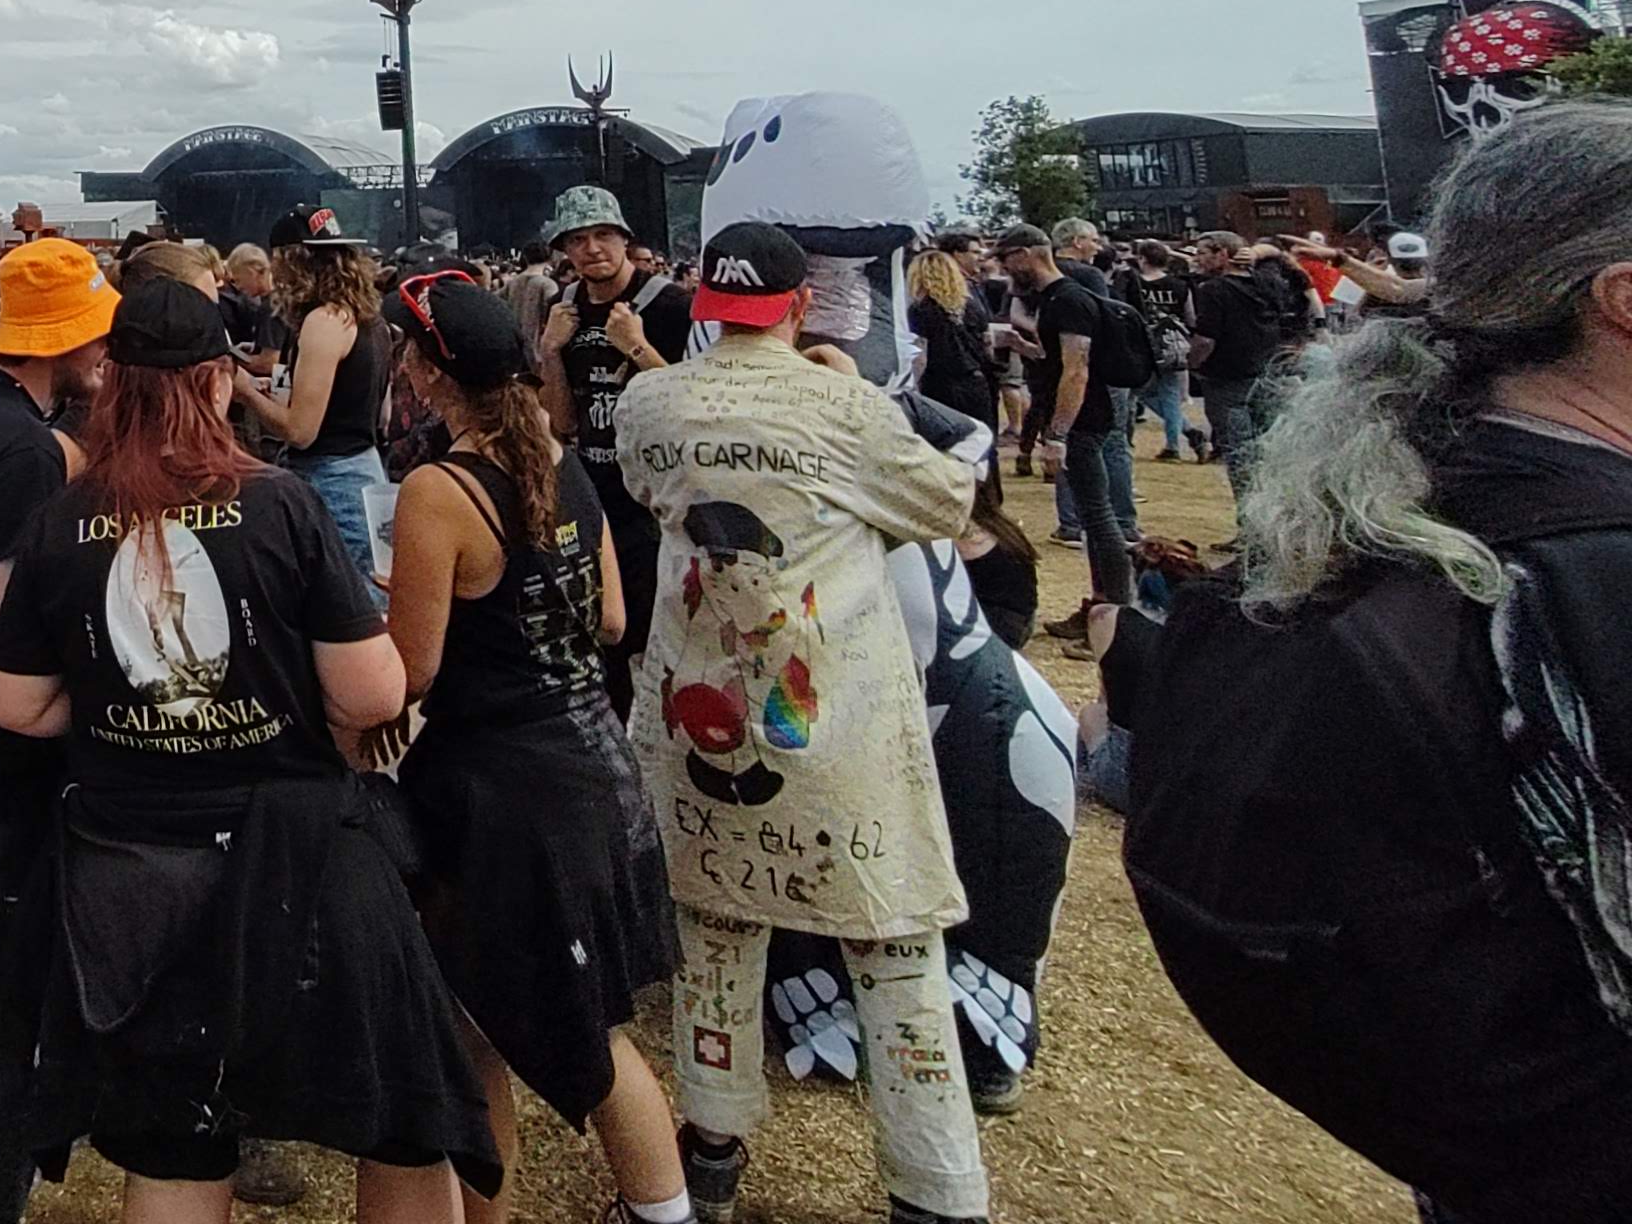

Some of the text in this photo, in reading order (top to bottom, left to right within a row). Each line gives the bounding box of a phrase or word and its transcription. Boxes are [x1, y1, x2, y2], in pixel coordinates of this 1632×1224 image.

[694, 441, 831, 484] CARNAGE
[77, 500, 243, 544] LOS AGELES
[106, 695, 268, 732] CALIFORNIA
[143, 733, 203, 754] STATES
[204, 736, 227, 751] OF
[229, 712, 295, 750] AMERICA
